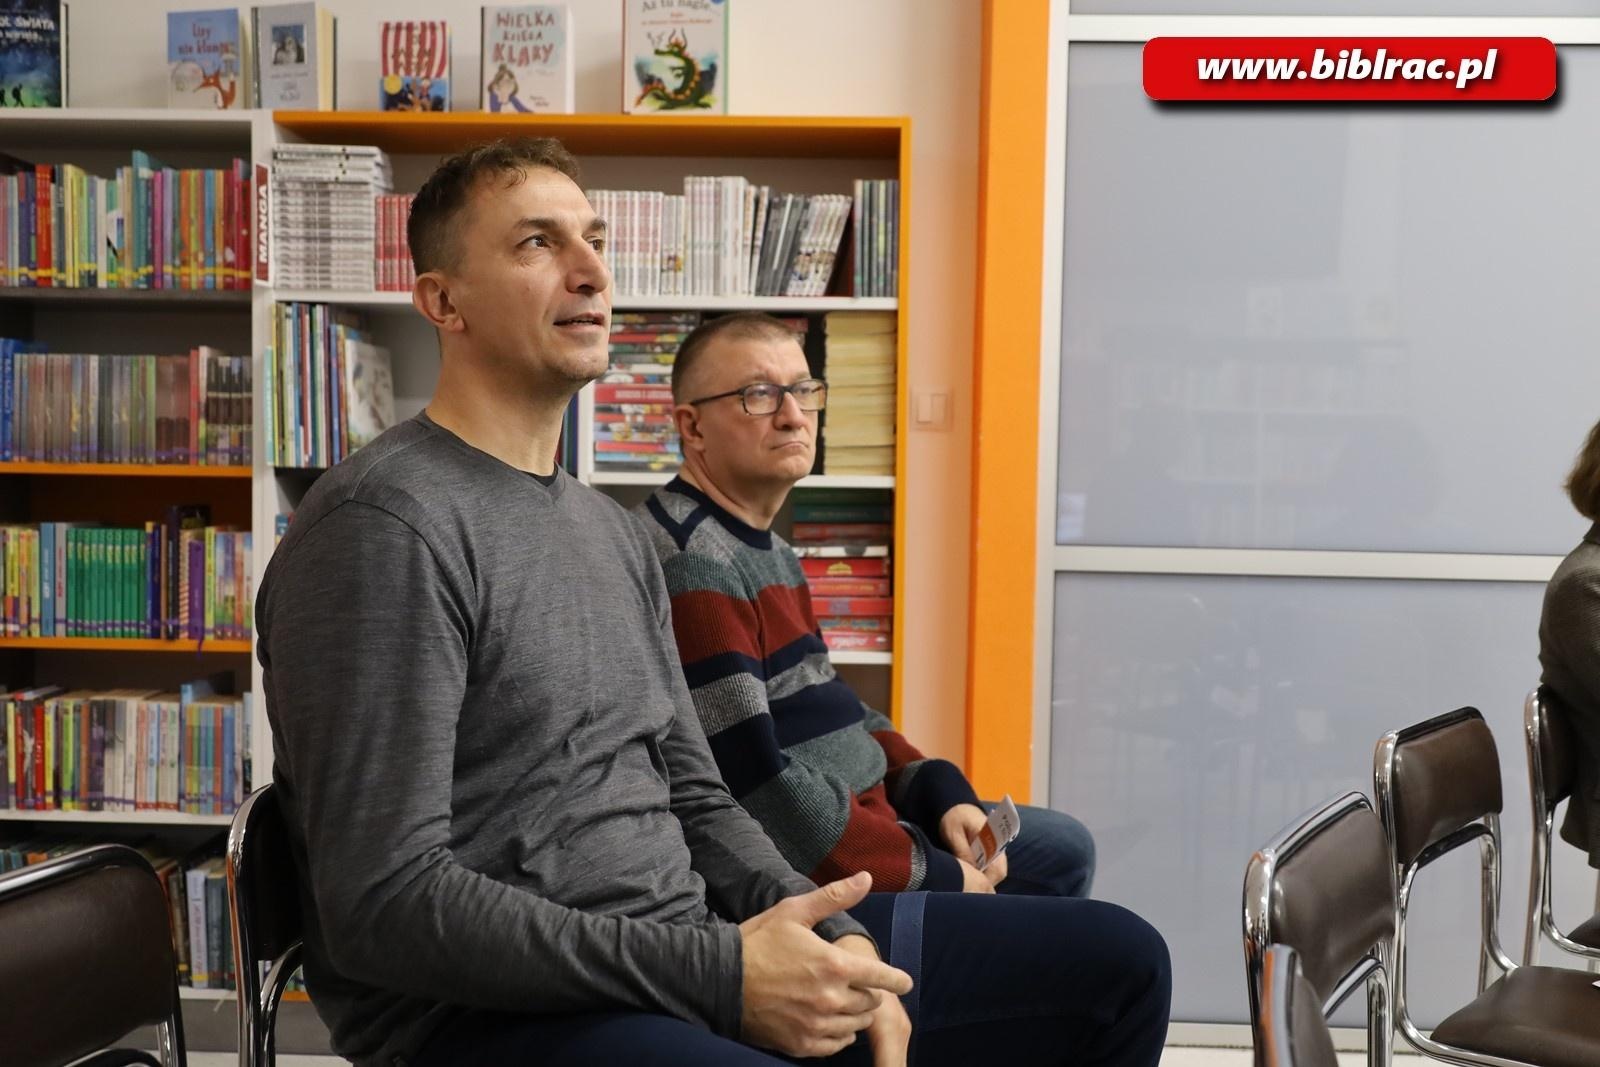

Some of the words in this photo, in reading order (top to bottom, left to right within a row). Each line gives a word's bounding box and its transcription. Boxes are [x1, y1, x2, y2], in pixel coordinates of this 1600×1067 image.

[496, 11, 555, 28] WIELKA
[492, 42, 555, 68] KLARY
[258, 183, 269, 264] MANGA
